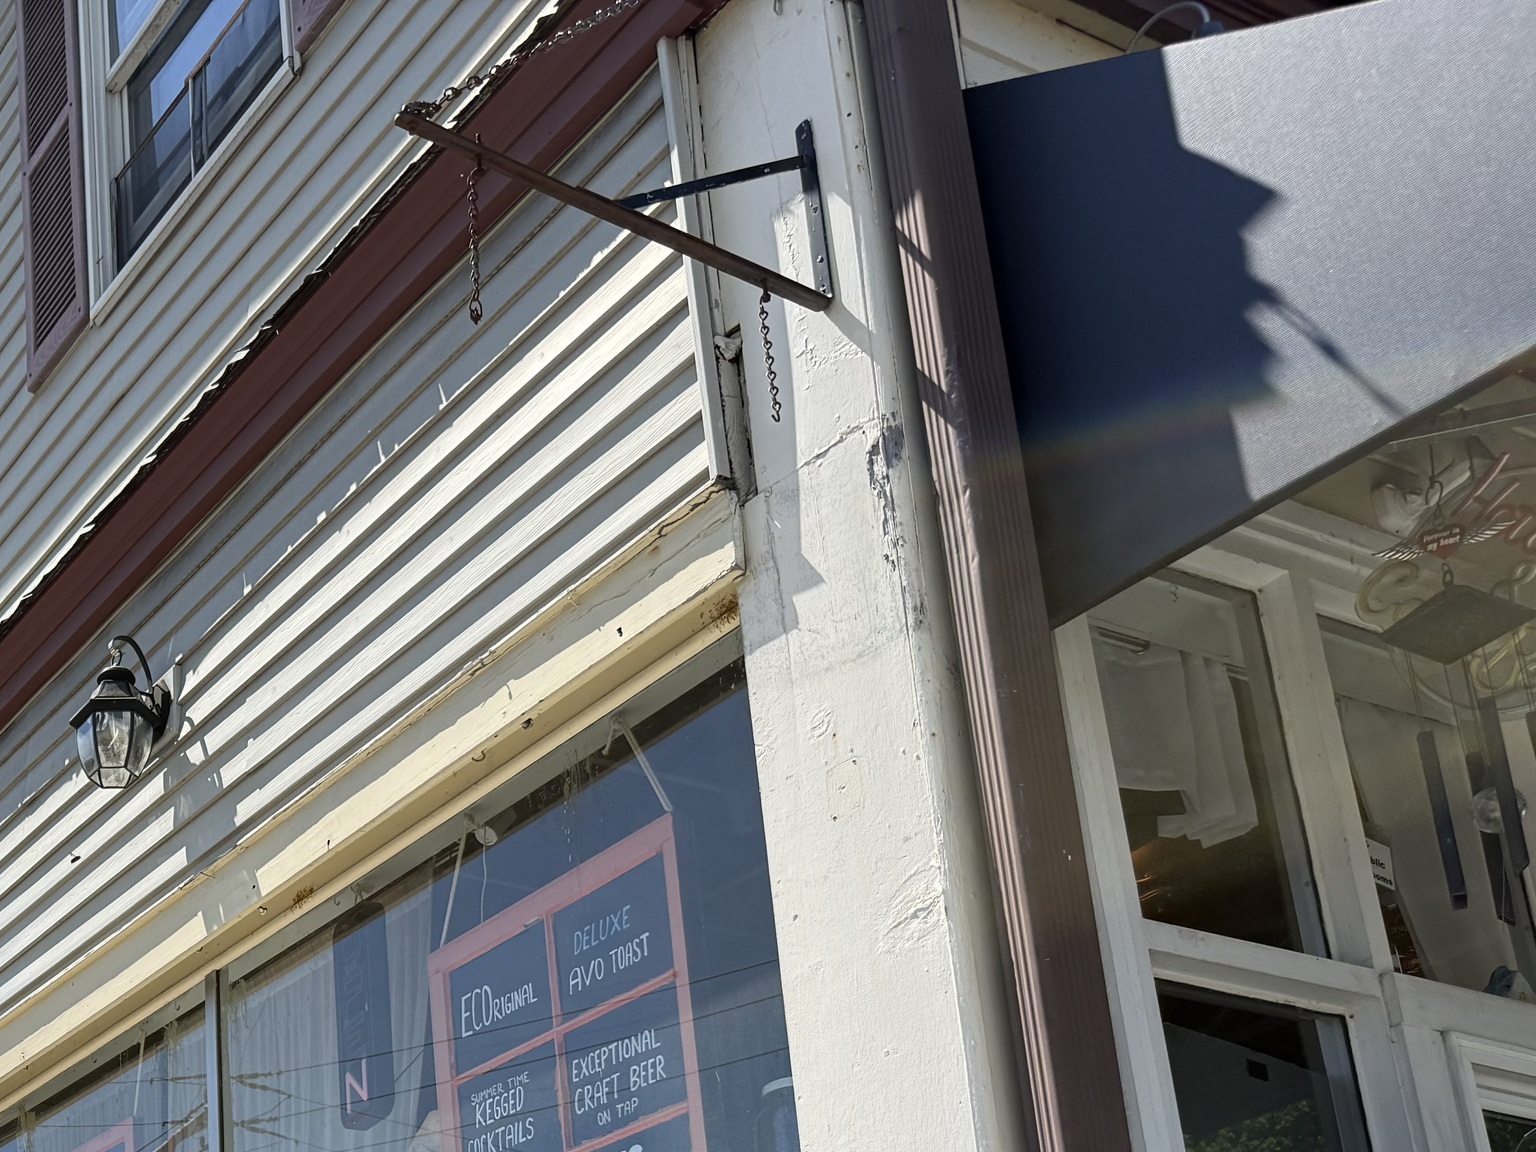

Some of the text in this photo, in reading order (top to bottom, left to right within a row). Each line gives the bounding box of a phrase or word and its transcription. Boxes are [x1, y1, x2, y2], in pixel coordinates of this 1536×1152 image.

[574, 905, 631, 955] DELUXE
[569, 932, 650, 995] AVO TOAST
[572, 1029, 661, 1082] EXCEPTIONAL
[471, 1071, 530, 1105] SUMMER TIME
[476, 1086, 524, 1128] KEGGED
[574, 1055, 666, 1115] CRAFT BEER
[597, 1098, 639, 1126] ON TAP
